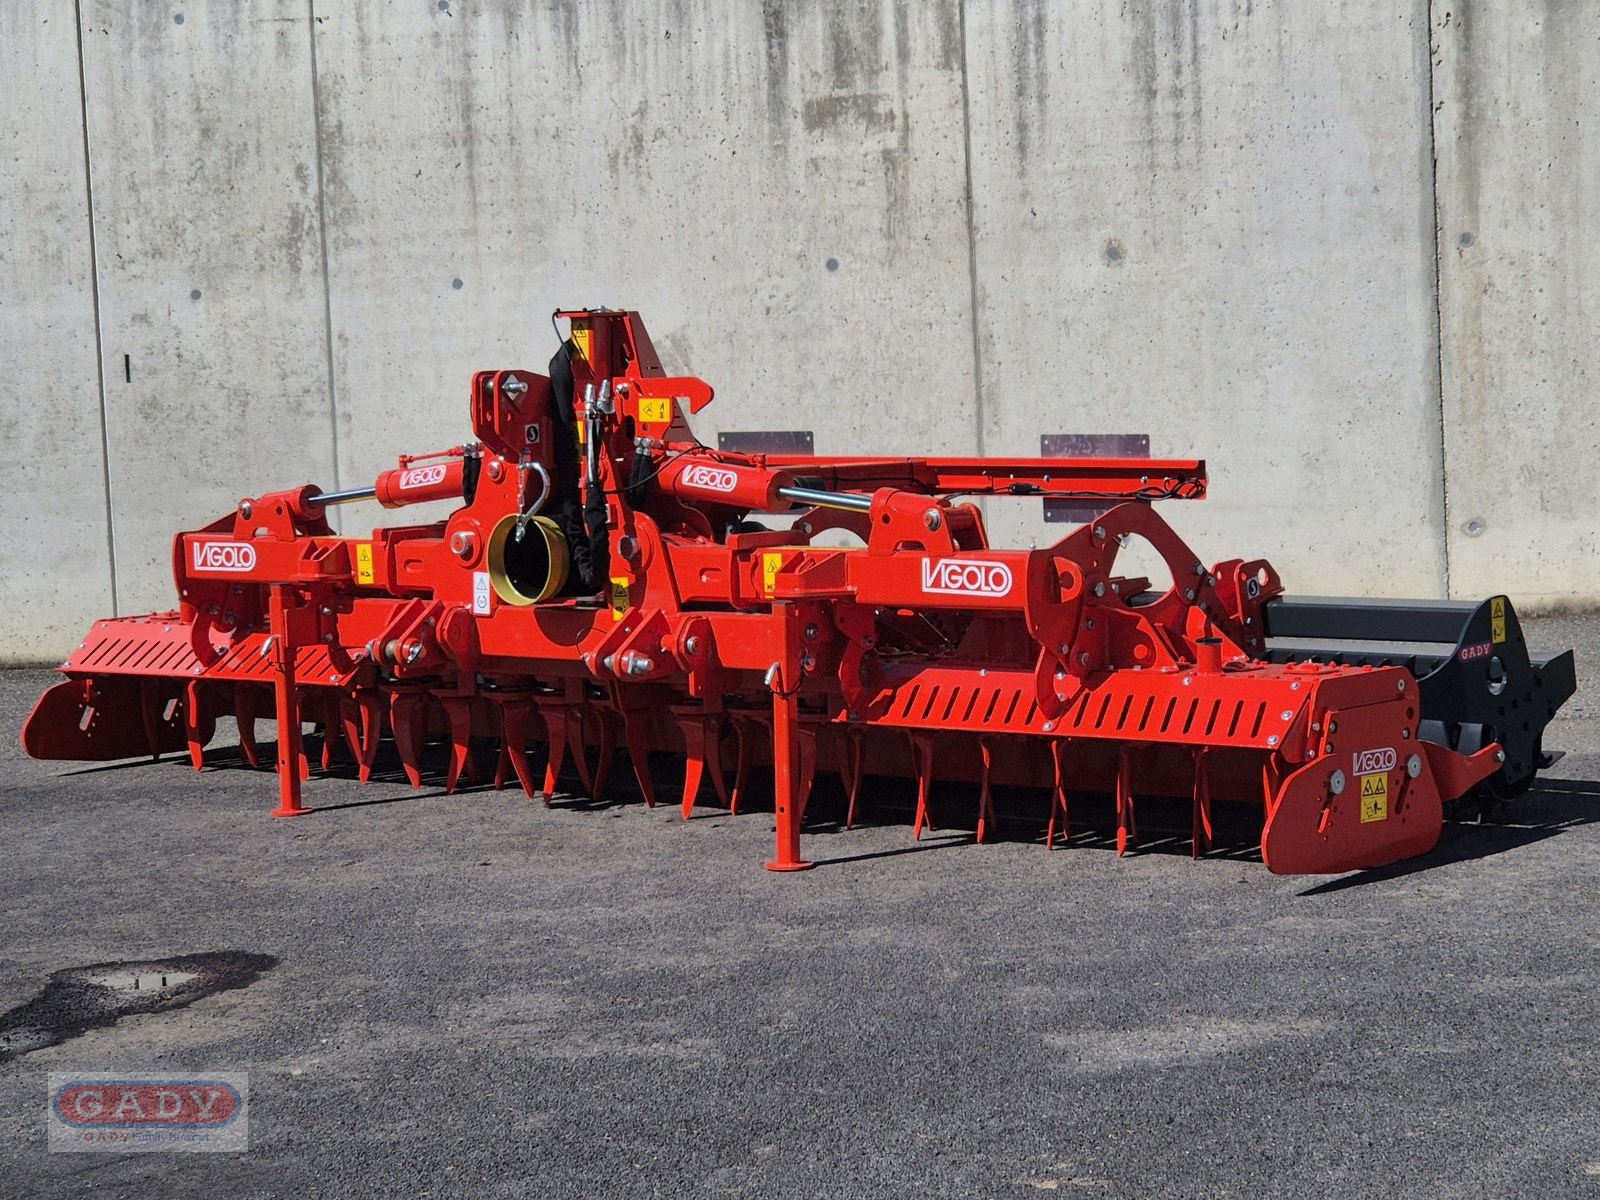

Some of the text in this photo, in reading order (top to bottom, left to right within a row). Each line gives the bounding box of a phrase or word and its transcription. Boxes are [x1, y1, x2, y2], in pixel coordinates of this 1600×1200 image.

[400, 464, 446, 490] VIGOLO
[682, 464, 737, 493] VIGOLO
[193, 542, 256, 572] VIGOLO
[922, 557, 1012, 597] VIGOLO
[1461, 642, 1491, 660] GADY
[1353, 747, 1396, 776] VIGOLO
